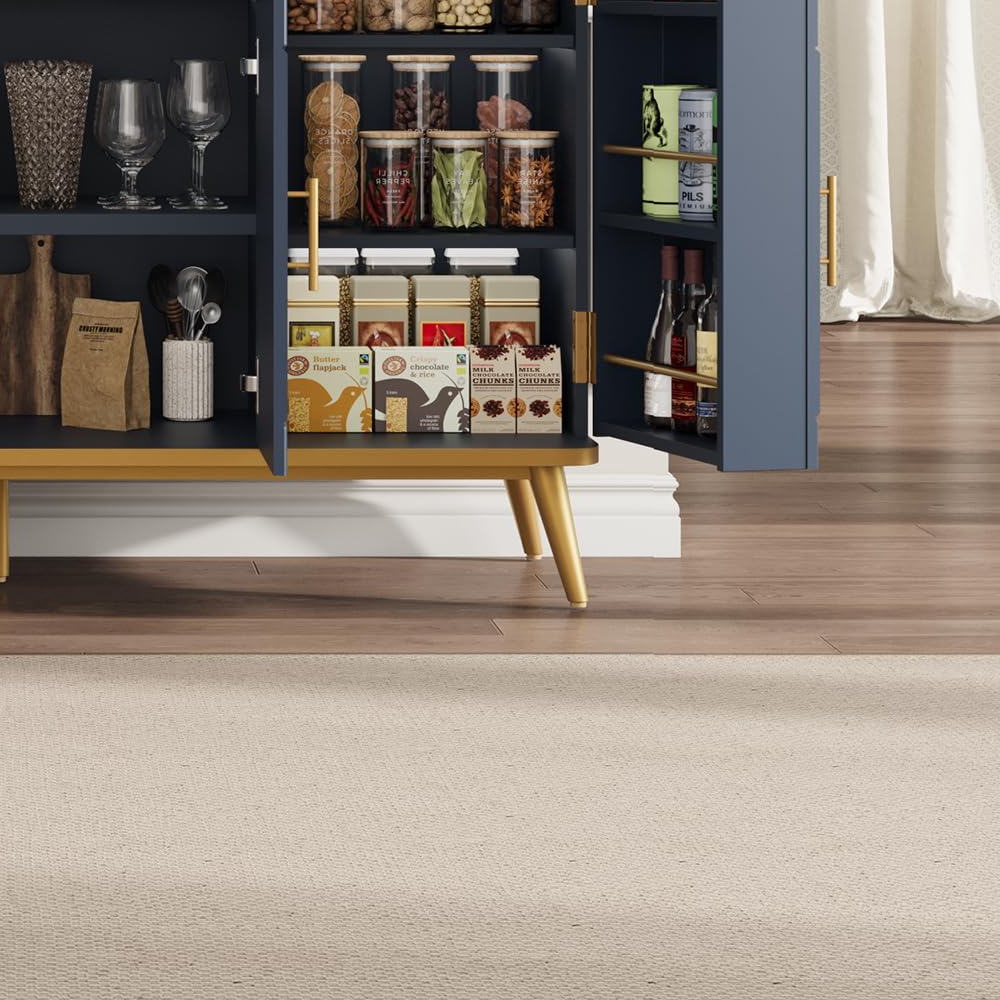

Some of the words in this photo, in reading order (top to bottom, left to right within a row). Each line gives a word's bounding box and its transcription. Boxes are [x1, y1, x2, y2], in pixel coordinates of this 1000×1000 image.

[681, 191, 704, 202] PILS
[313, 355, 341, 363] Butter
[313, 364, 347, 373] flapjack
[409, 363, 449, 371] chocolate
